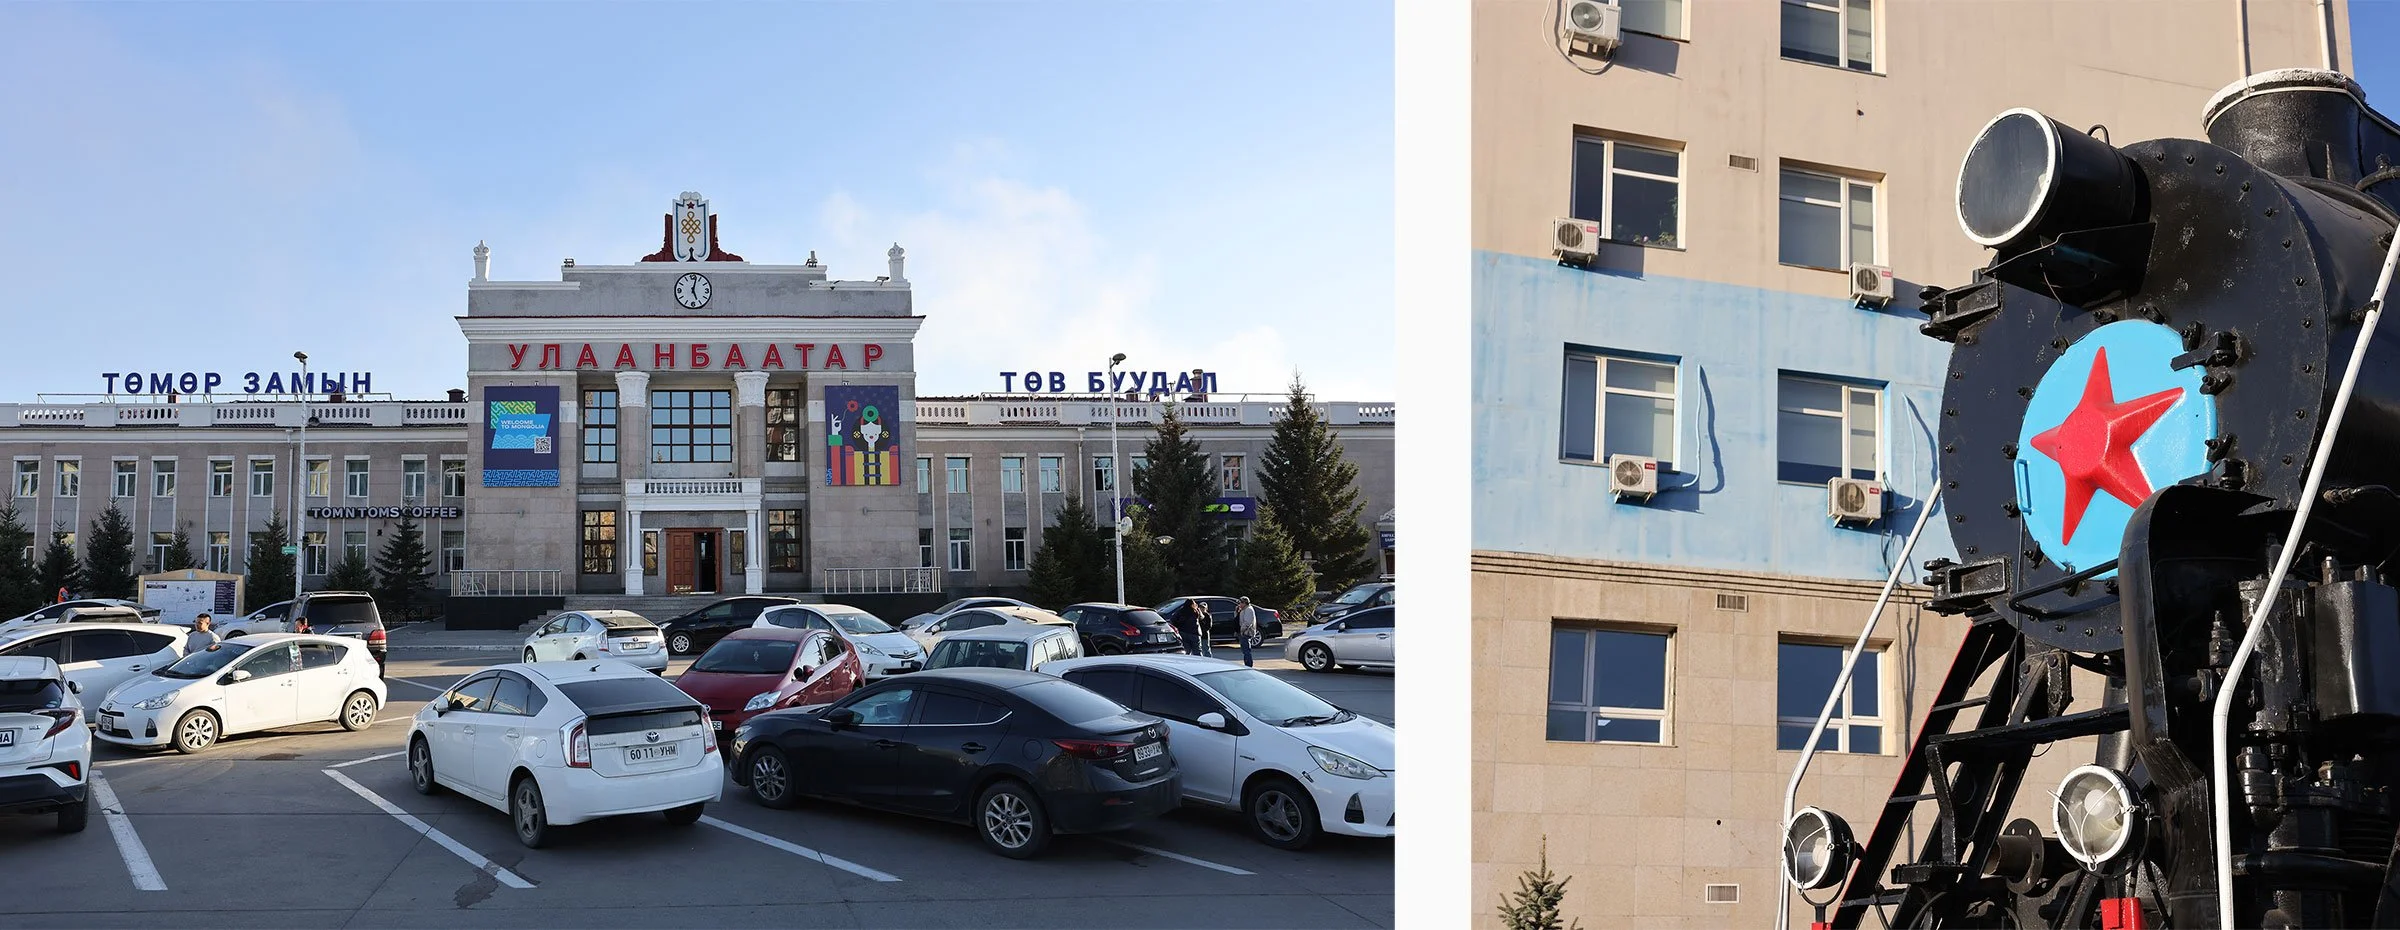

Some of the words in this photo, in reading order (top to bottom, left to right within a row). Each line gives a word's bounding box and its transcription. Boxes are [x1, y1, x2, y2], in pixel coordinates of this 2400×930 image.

[507, 343, 886, 370] УЛААНБААТАР
[102, 372, 222, 395] ТӨМӨР
[243, 372, 371, 395] ЗАМЫН
[1000, 371, 1066, 393] ТӨВ
[1088, 371, 1217, 396] БУУДАЛ
[630, 748, 641, 761] 60
[643, 747, 655, 759] 11
